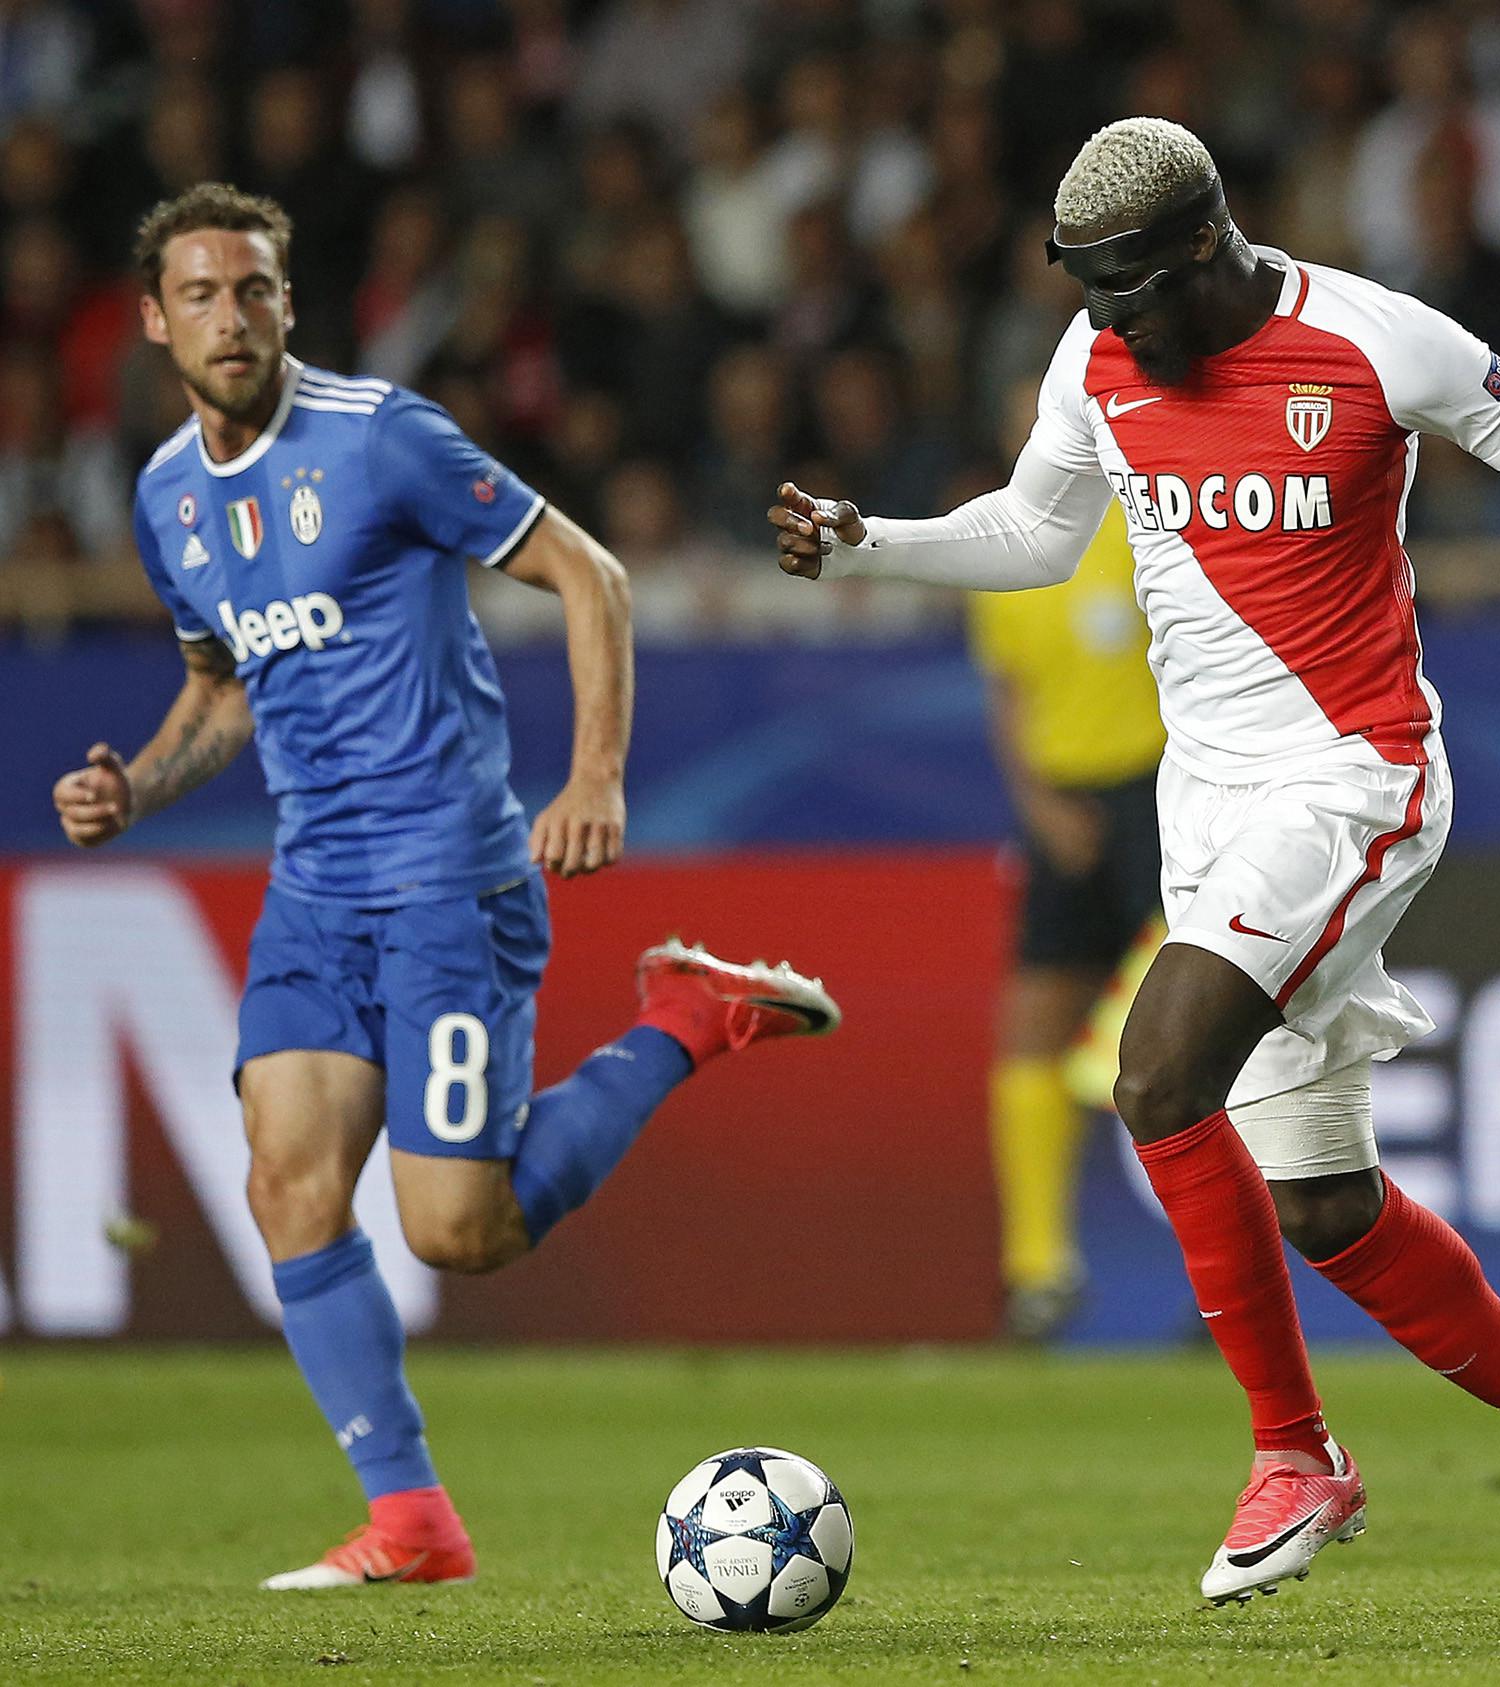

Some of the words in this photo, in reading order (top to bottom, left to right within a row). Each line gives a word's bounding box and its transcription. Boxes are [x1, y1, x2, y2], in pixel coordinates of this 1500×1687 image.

[217, 591, 344, 664] Jeep
[0, 863, 440, 1336] N
[424, 1012, 490, 1143] 8
[719, 1490, 755, 1499] adidas
[713, 1564, 760, 1577] FINAL
